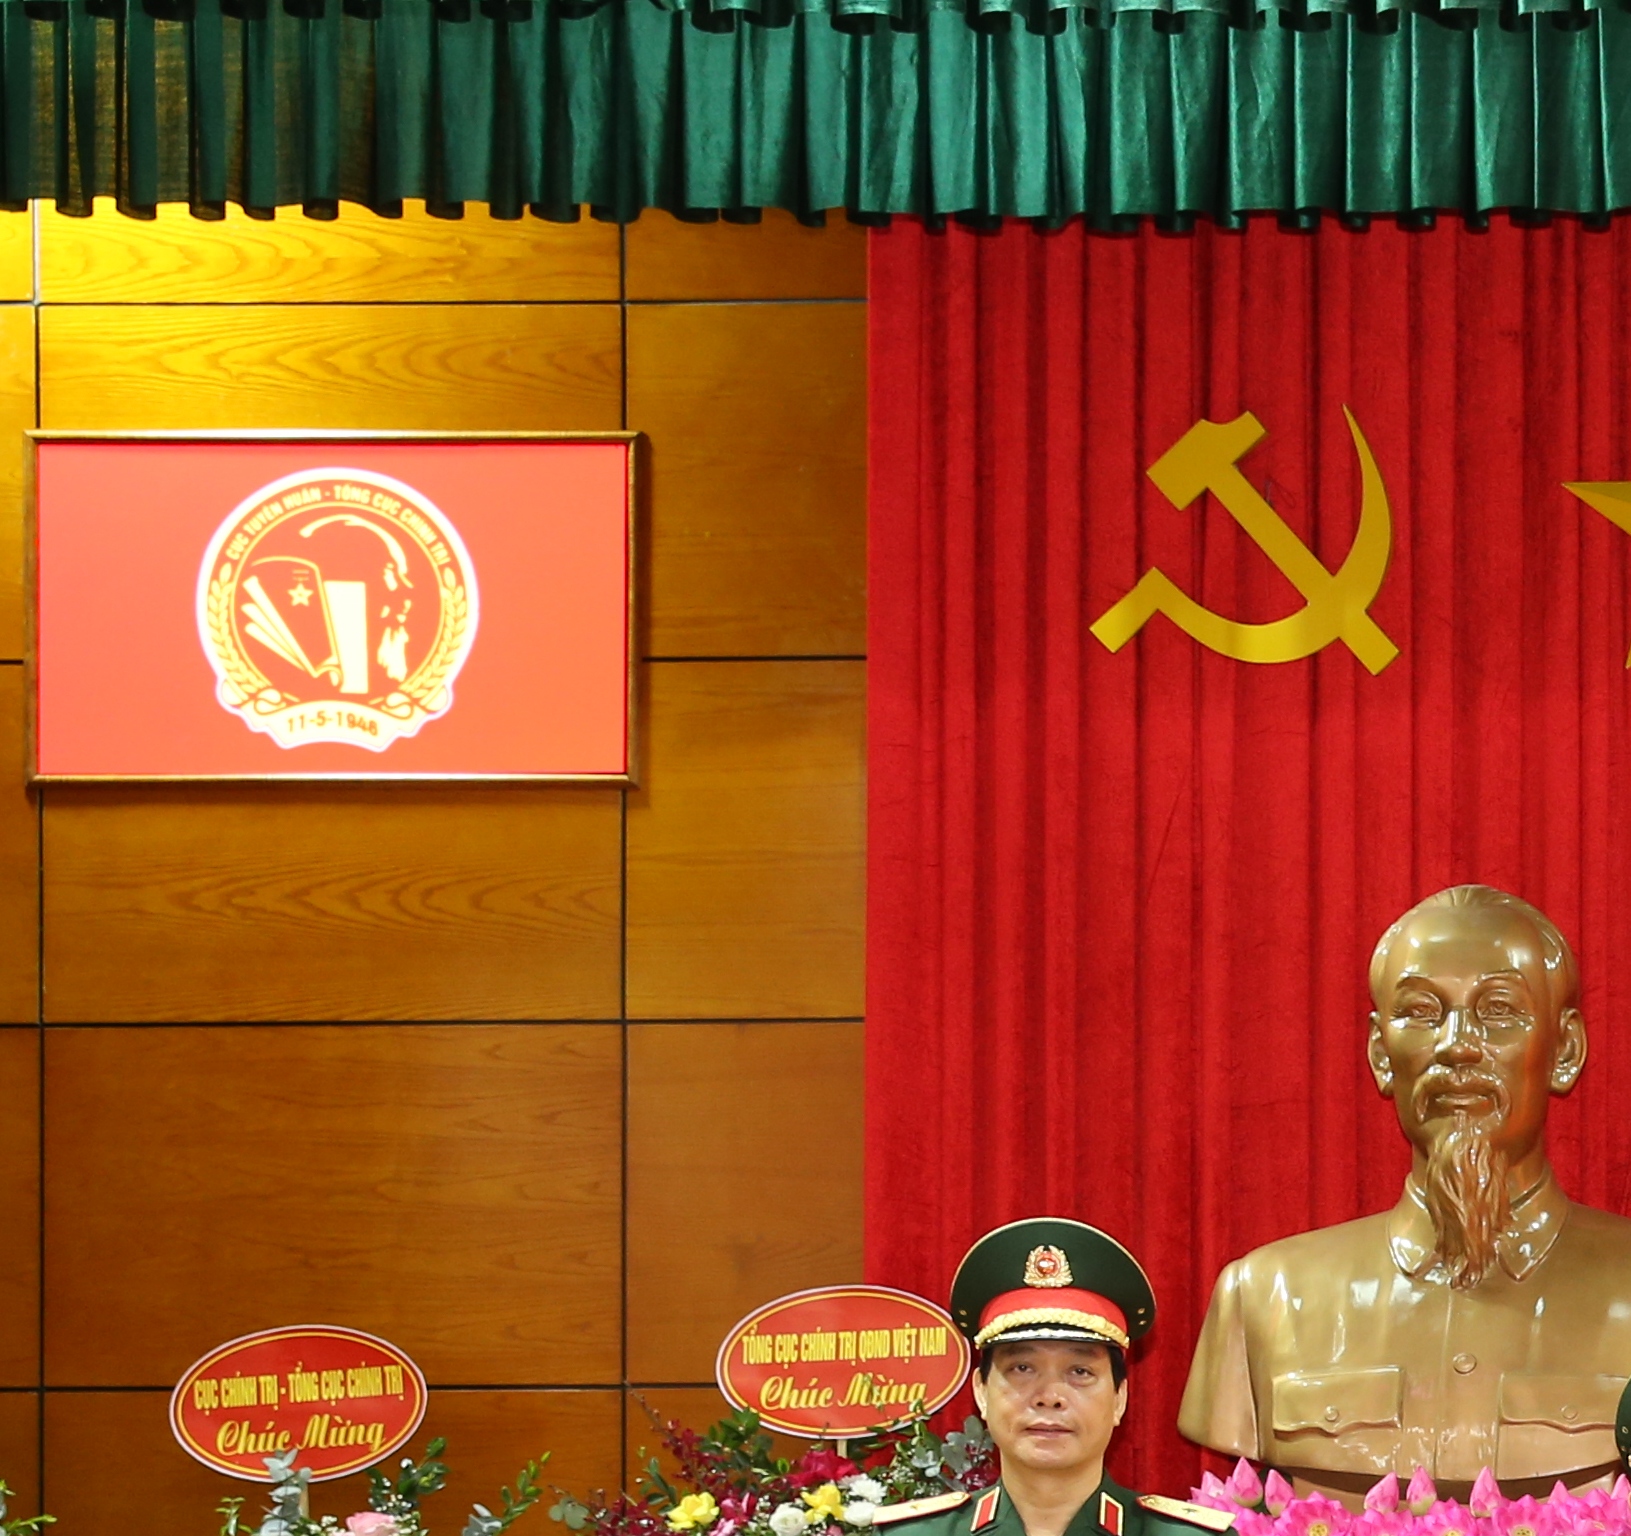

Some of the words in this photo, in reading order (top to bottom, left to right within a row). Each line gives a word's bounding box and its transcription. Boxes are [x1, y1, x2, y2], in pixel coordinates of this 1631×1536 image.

[742, 1324, 772, 1364] TỔNG
[774, 1333, 798, 1370] CỤC
[801, 1327, 836, 1362] CHÍNH
[838, 1331, 857, 1367] TRỊ
[892, 1322, 918, 1364] VIỆT
[919, 1326, 947, 1357] NAM
[194, 1379, 219, 1416] CỤC
[221, 1371, 257, 1408] CHÍNH
[258, 1375, 279, 1411] TRỊ
[287, 1361, 319, 1403] TỔNG
[320, 1370, 345, 1406] CỤC
[346, 1361, 383, 1399] CHÍNH
[384, 1365, 404, 1401] TRỊ
[759, 1376, 833, 1411] Chúc
[216, 1420, 292, 1456] Chúc
[295, 1413, 386, 1453] Mừng
